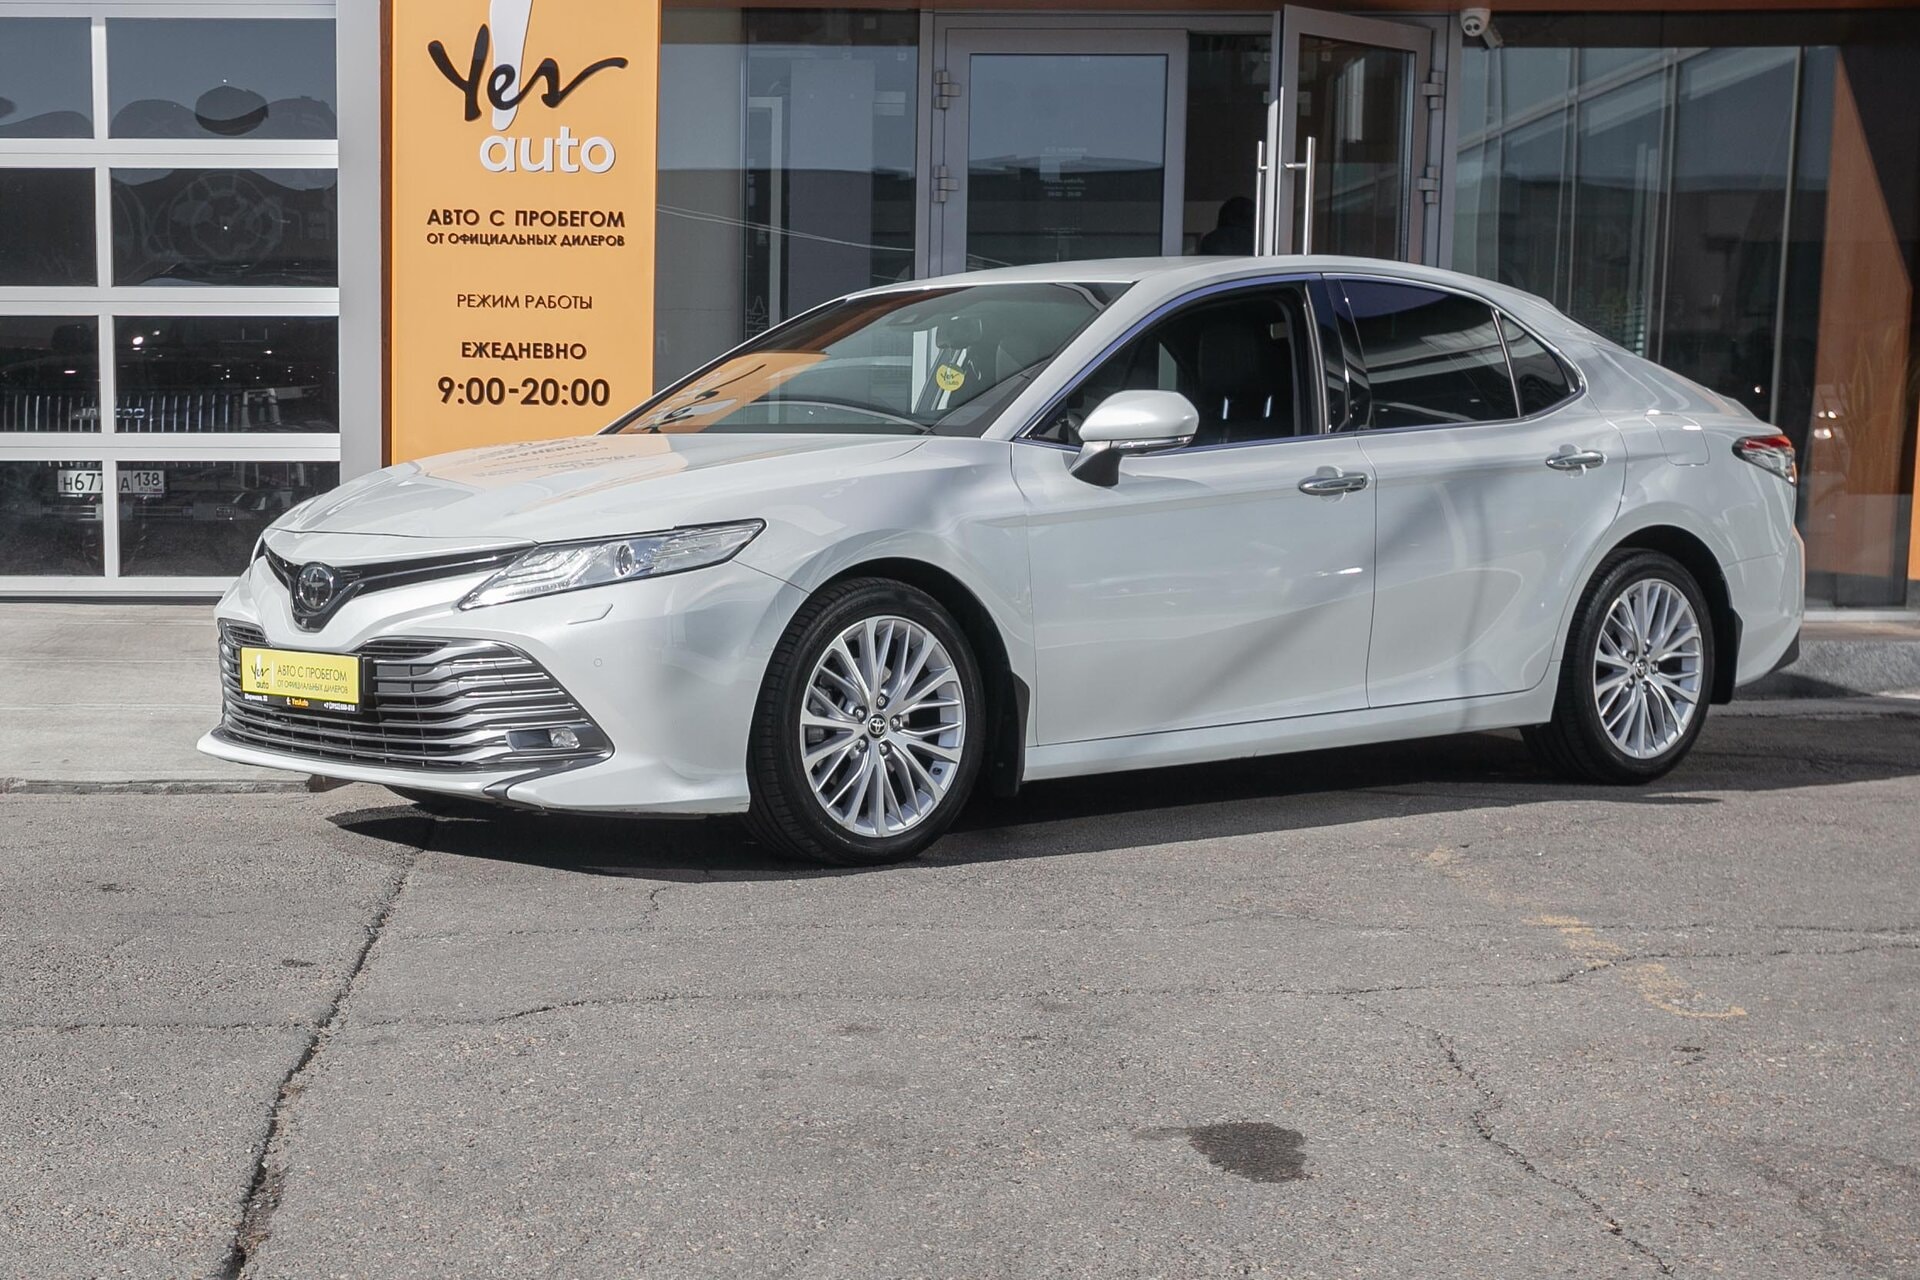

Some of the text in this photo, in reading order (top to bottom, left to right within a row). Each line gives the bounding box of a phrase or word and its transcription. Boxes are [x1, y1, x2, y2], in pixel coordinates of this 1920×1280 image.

[428, 24, 628, 121] Yes
[480, 126, 616, 173] auto
[427, 209, 626, 228] АВТО С ПРОБЕГОМ
[427, 232, 625, 247] ОТ ОФИЦИАЛЬНЫХ ДИЛЕРОВ
[457, 294, 593, 310] РЕЖИМ РАБОТЫ
[461, 342, 587, 361] ЕЖЕДНЕВНО
[438, 376, 611, 407] 9:00-20:00
[134, 471, 160, 487] 138
[277, 665, 347, 681] АВТО С ПРОБЕГОМ
[256, 681, 269, 689] auto
[277, 680, 348, 694] ОТ ОФИЦИАЛЬНЫХ ДИЛЕРОВ
